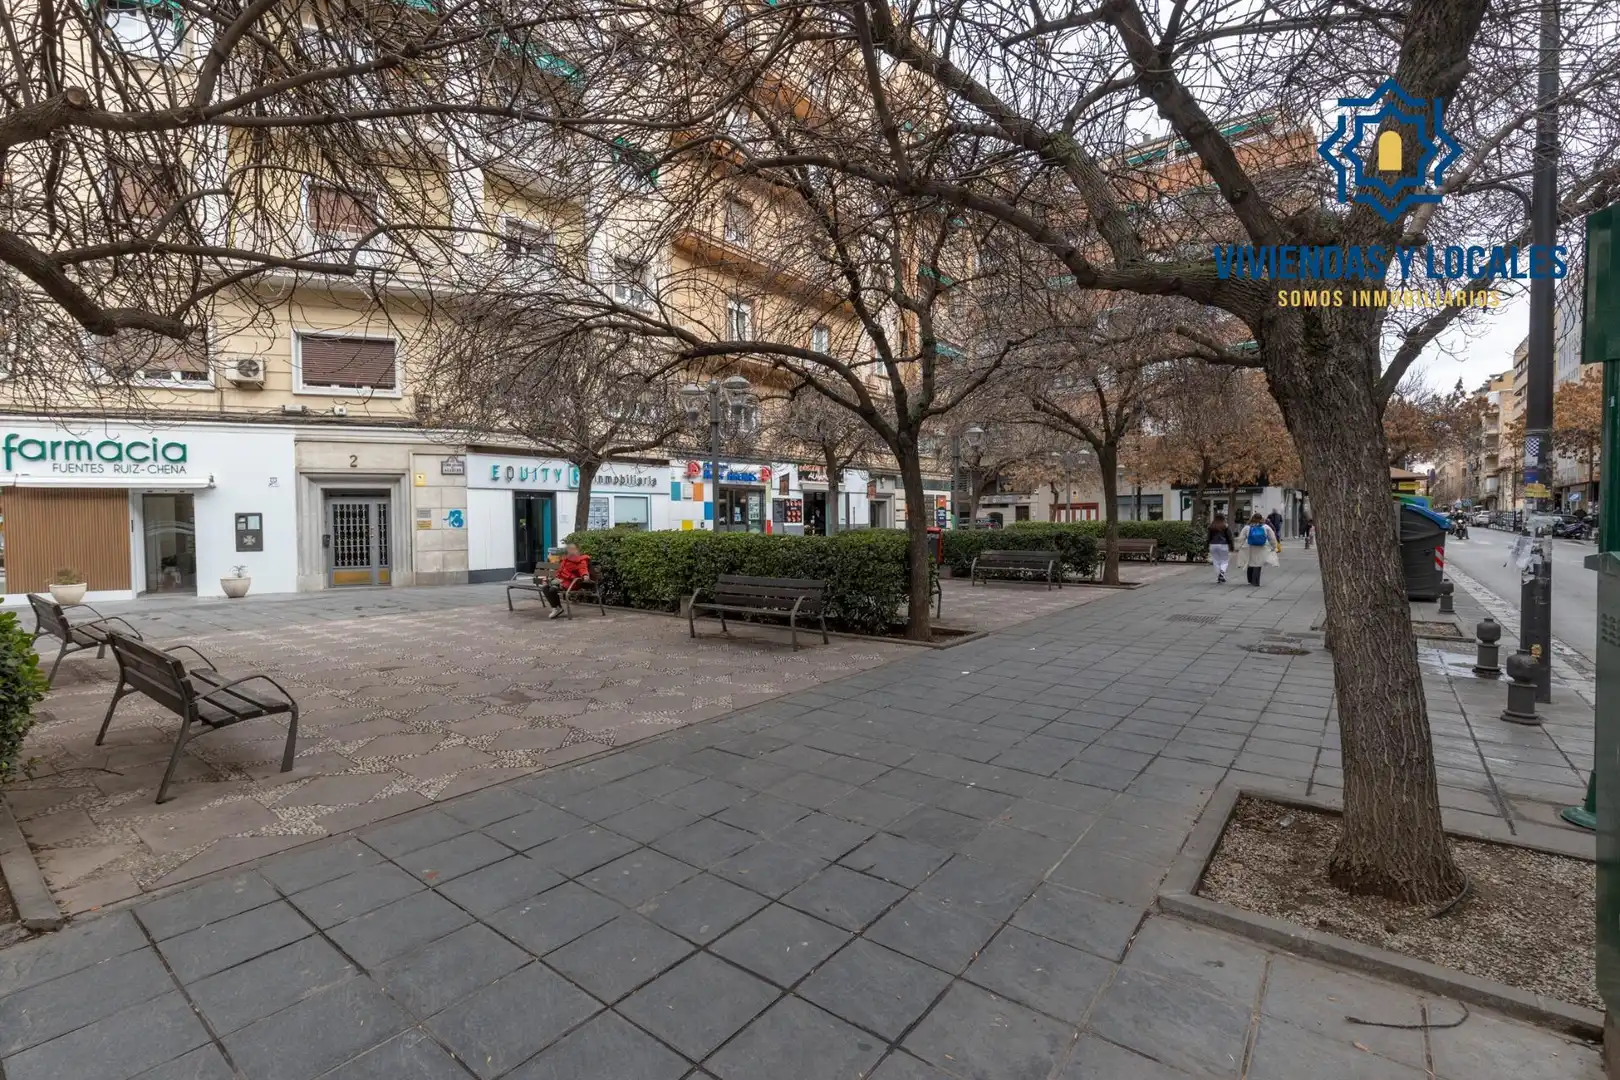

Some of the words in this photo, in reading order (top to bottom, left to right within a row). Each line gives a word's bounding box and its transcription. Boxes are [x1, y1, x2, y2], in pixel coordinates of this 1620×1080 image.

[349, 454, 359, 468] 2
[52, 463, 105, 474] FUENTES
[113, 463, 188, 475] RUIZ-CHENA
[491, 464, 563, 482] EQUITY
[593, 473, 658, 488] inmobiliaria
